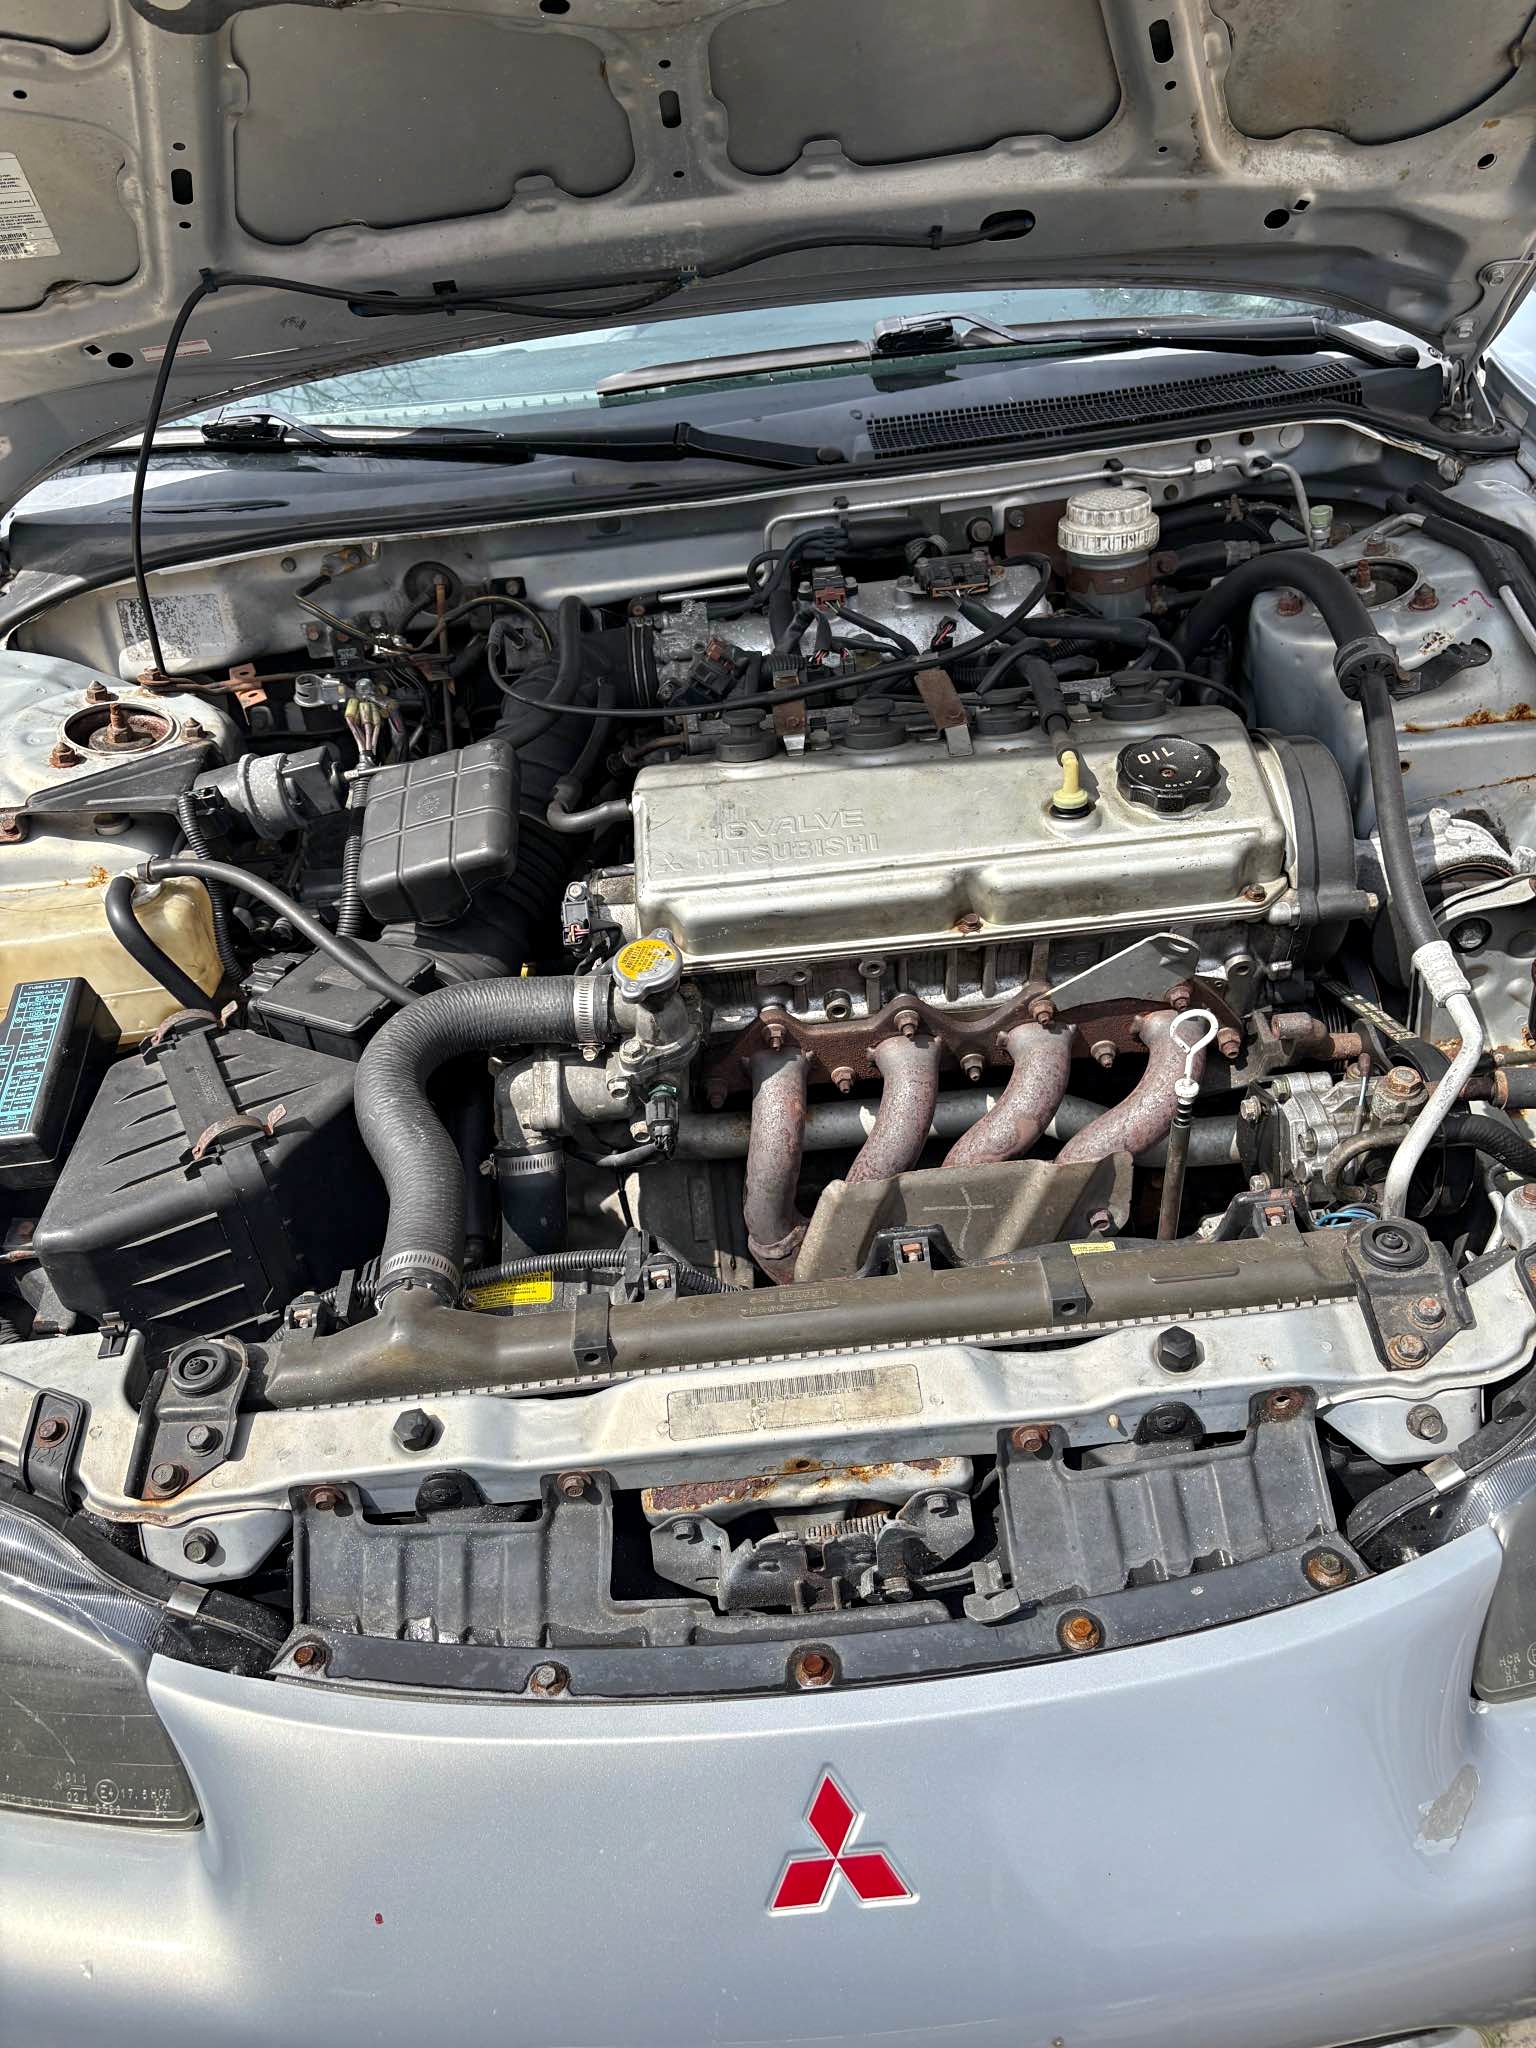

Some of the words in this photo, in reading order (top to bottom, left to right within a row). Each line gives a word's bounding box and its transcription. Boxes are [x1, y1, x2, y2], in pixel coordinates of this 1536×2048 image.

[1137, 747, 1175, 764] OIL
[696, 832, 880, 869] MITSUBISHI
[508, 1275, 549, 1284] ATTENTION
